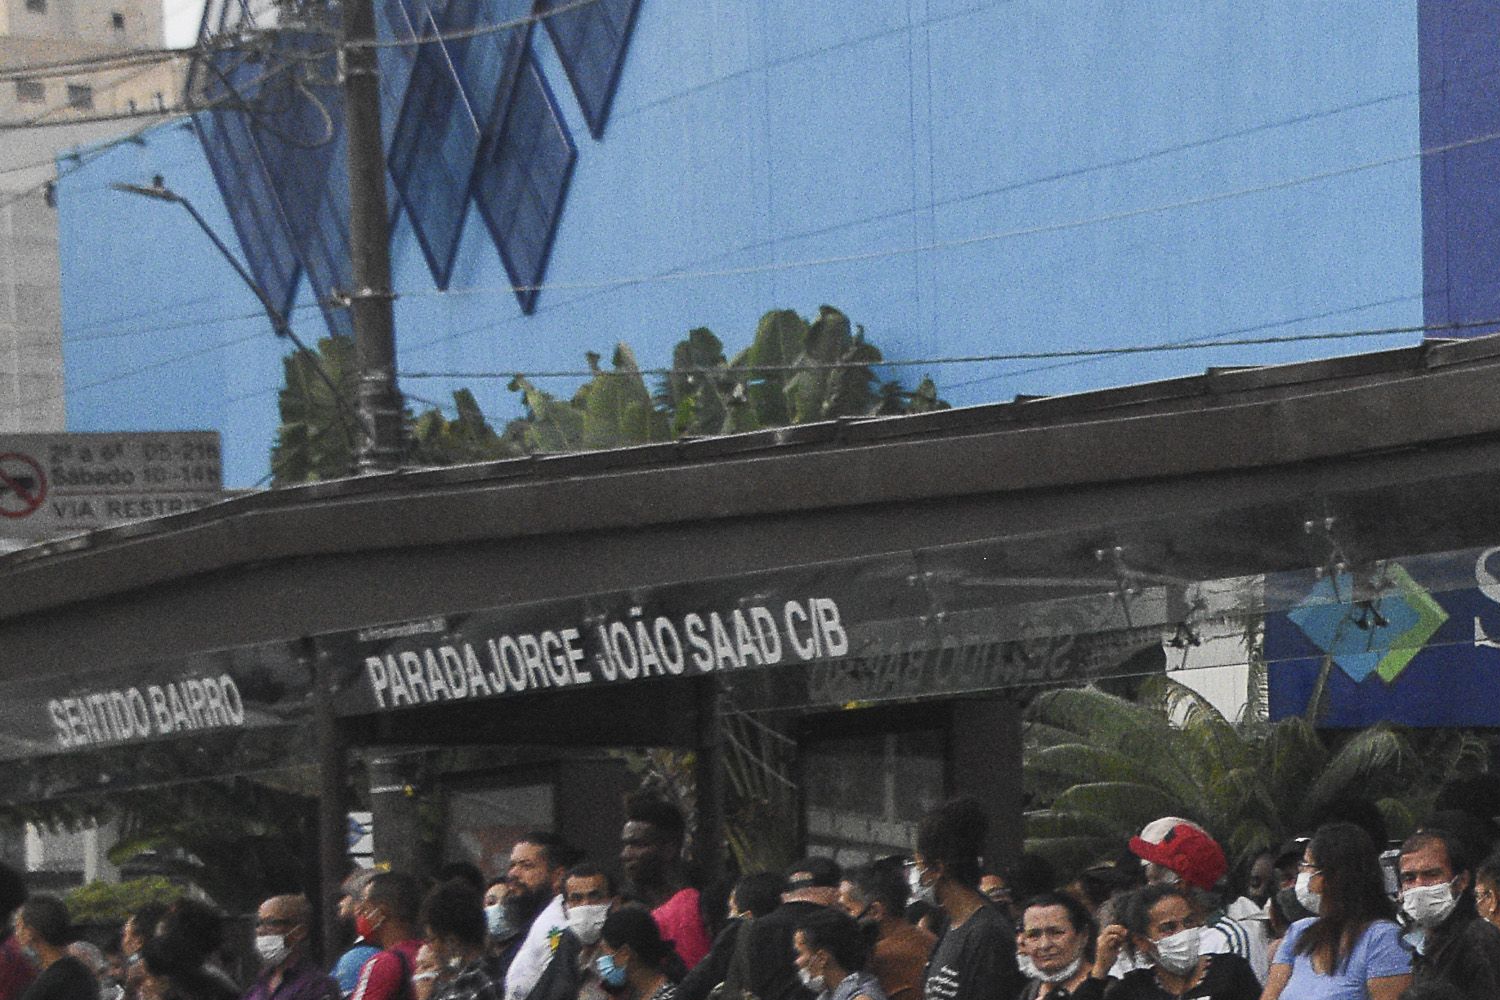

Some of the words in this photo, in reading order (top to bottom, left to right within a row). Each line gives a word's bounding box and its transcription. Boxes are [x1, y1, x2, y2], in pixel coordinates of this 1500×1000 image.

[52, 500, 96, 518] VIA
[365, 643, 490, 708] PARADA
[487, 628, 592, 695] JORGE
[595, 606, 684, 682] JOÃO
[686, 606, 782, 672] SAAD
[783, 597, 849, 659] C/B
[47, 686, 151, 748] SENTIDO
[150, 674, 245, 734] BAIRRO
